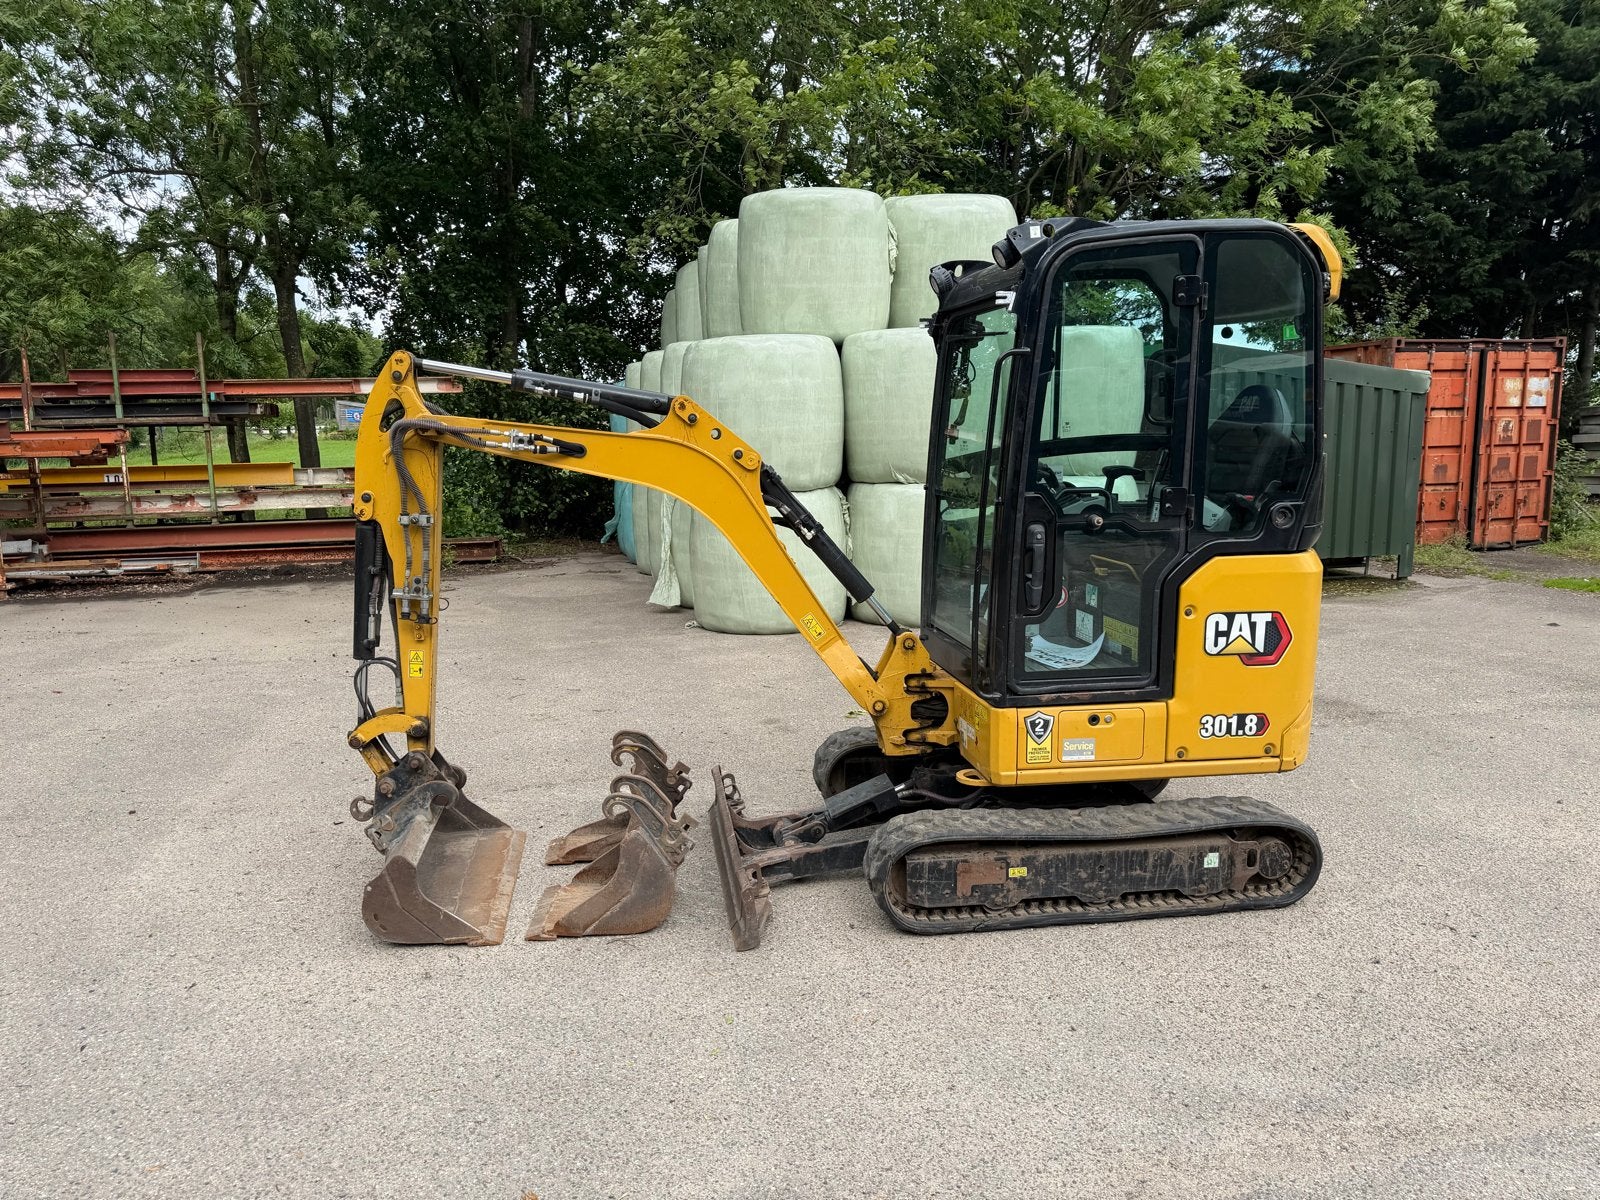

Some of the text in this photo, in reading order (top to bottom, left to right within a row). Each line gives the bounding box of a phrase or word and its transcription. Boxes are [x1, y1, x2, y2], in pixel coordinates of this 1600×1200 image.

[1205, 613, 1272, 654] CAT
[1035, 718, 1044, 731] 2
[1200, 714, 1258, 737] 301.8
[1063, 741, 1094, 751] Service
